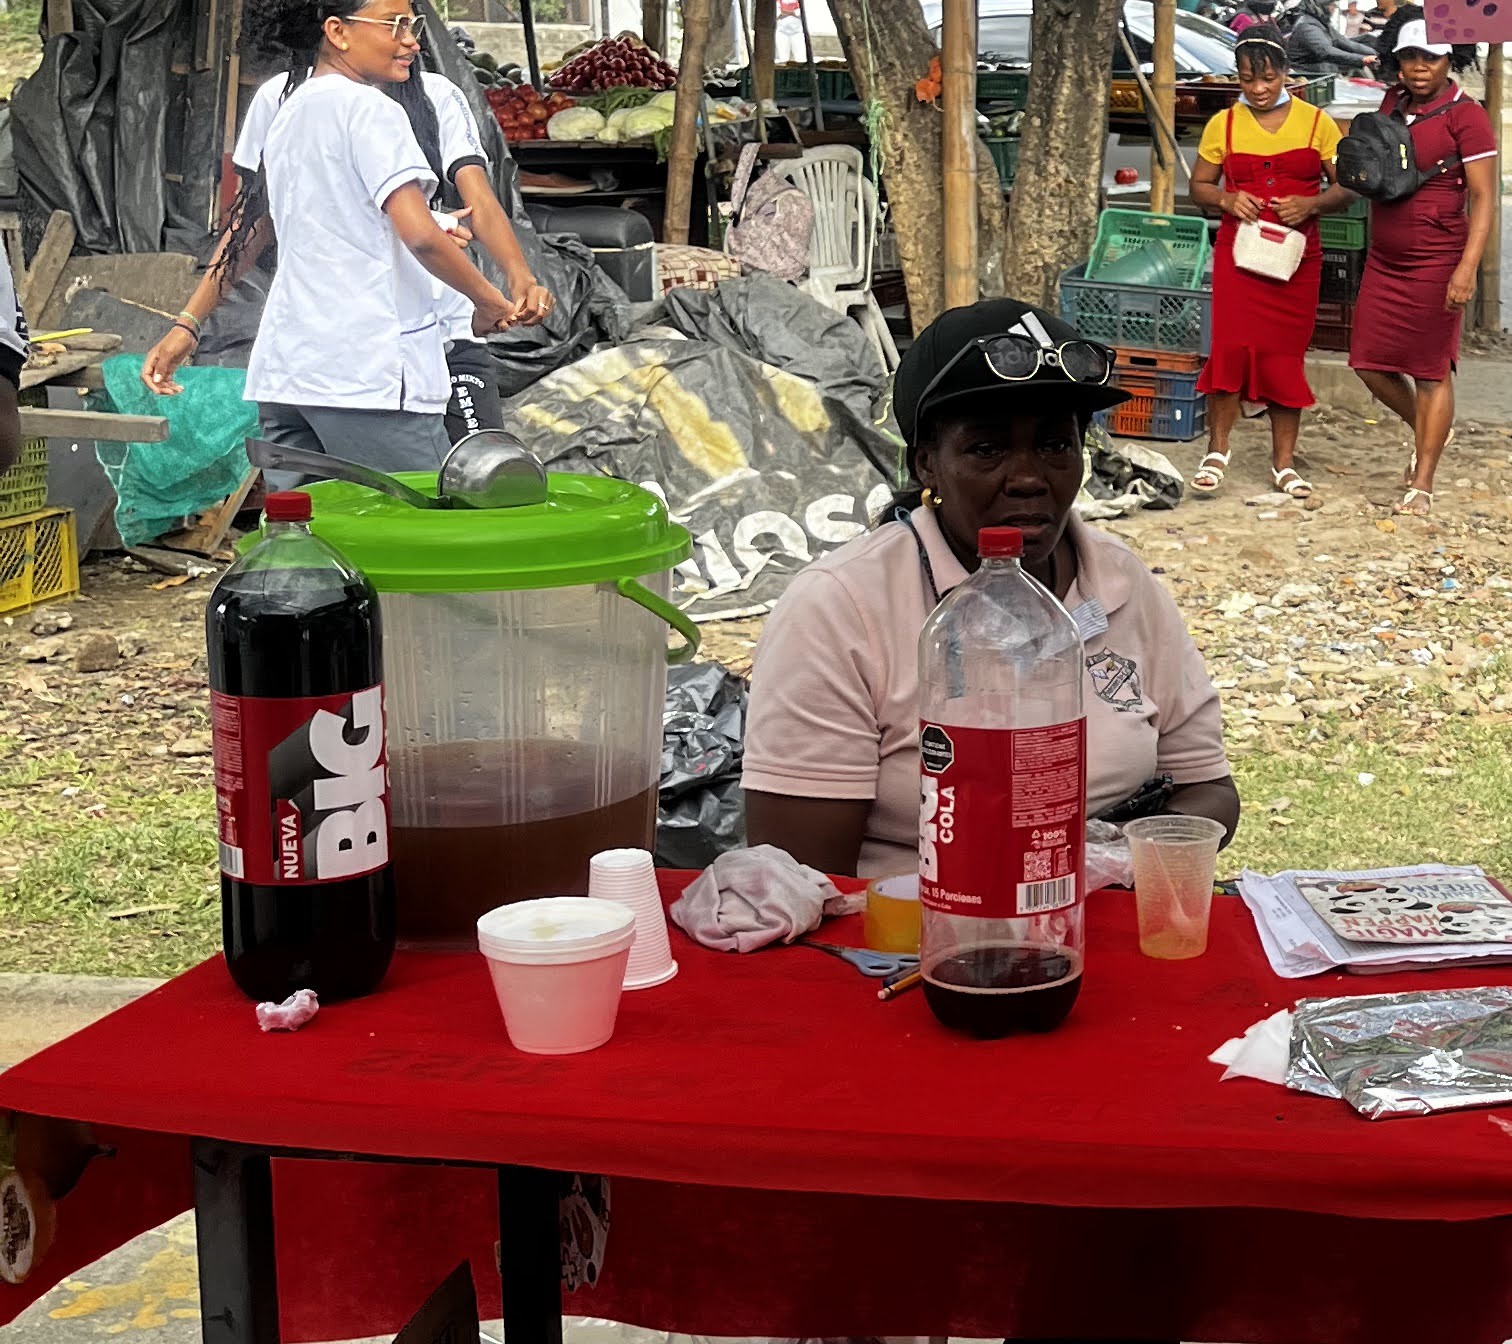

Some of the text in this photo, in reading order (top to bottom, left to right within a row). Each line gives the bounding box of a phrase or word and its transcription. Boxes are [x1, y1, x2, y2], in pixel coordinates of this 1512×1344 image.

[309, 685, 388, 880] BIG
[939, 786, 955, 844] COLA
[281, 814, 299, 879] NUEVA
[1341, 913, 1440, 928] HAPPEN
[1346, 925, 1444, 938] MAGIC
